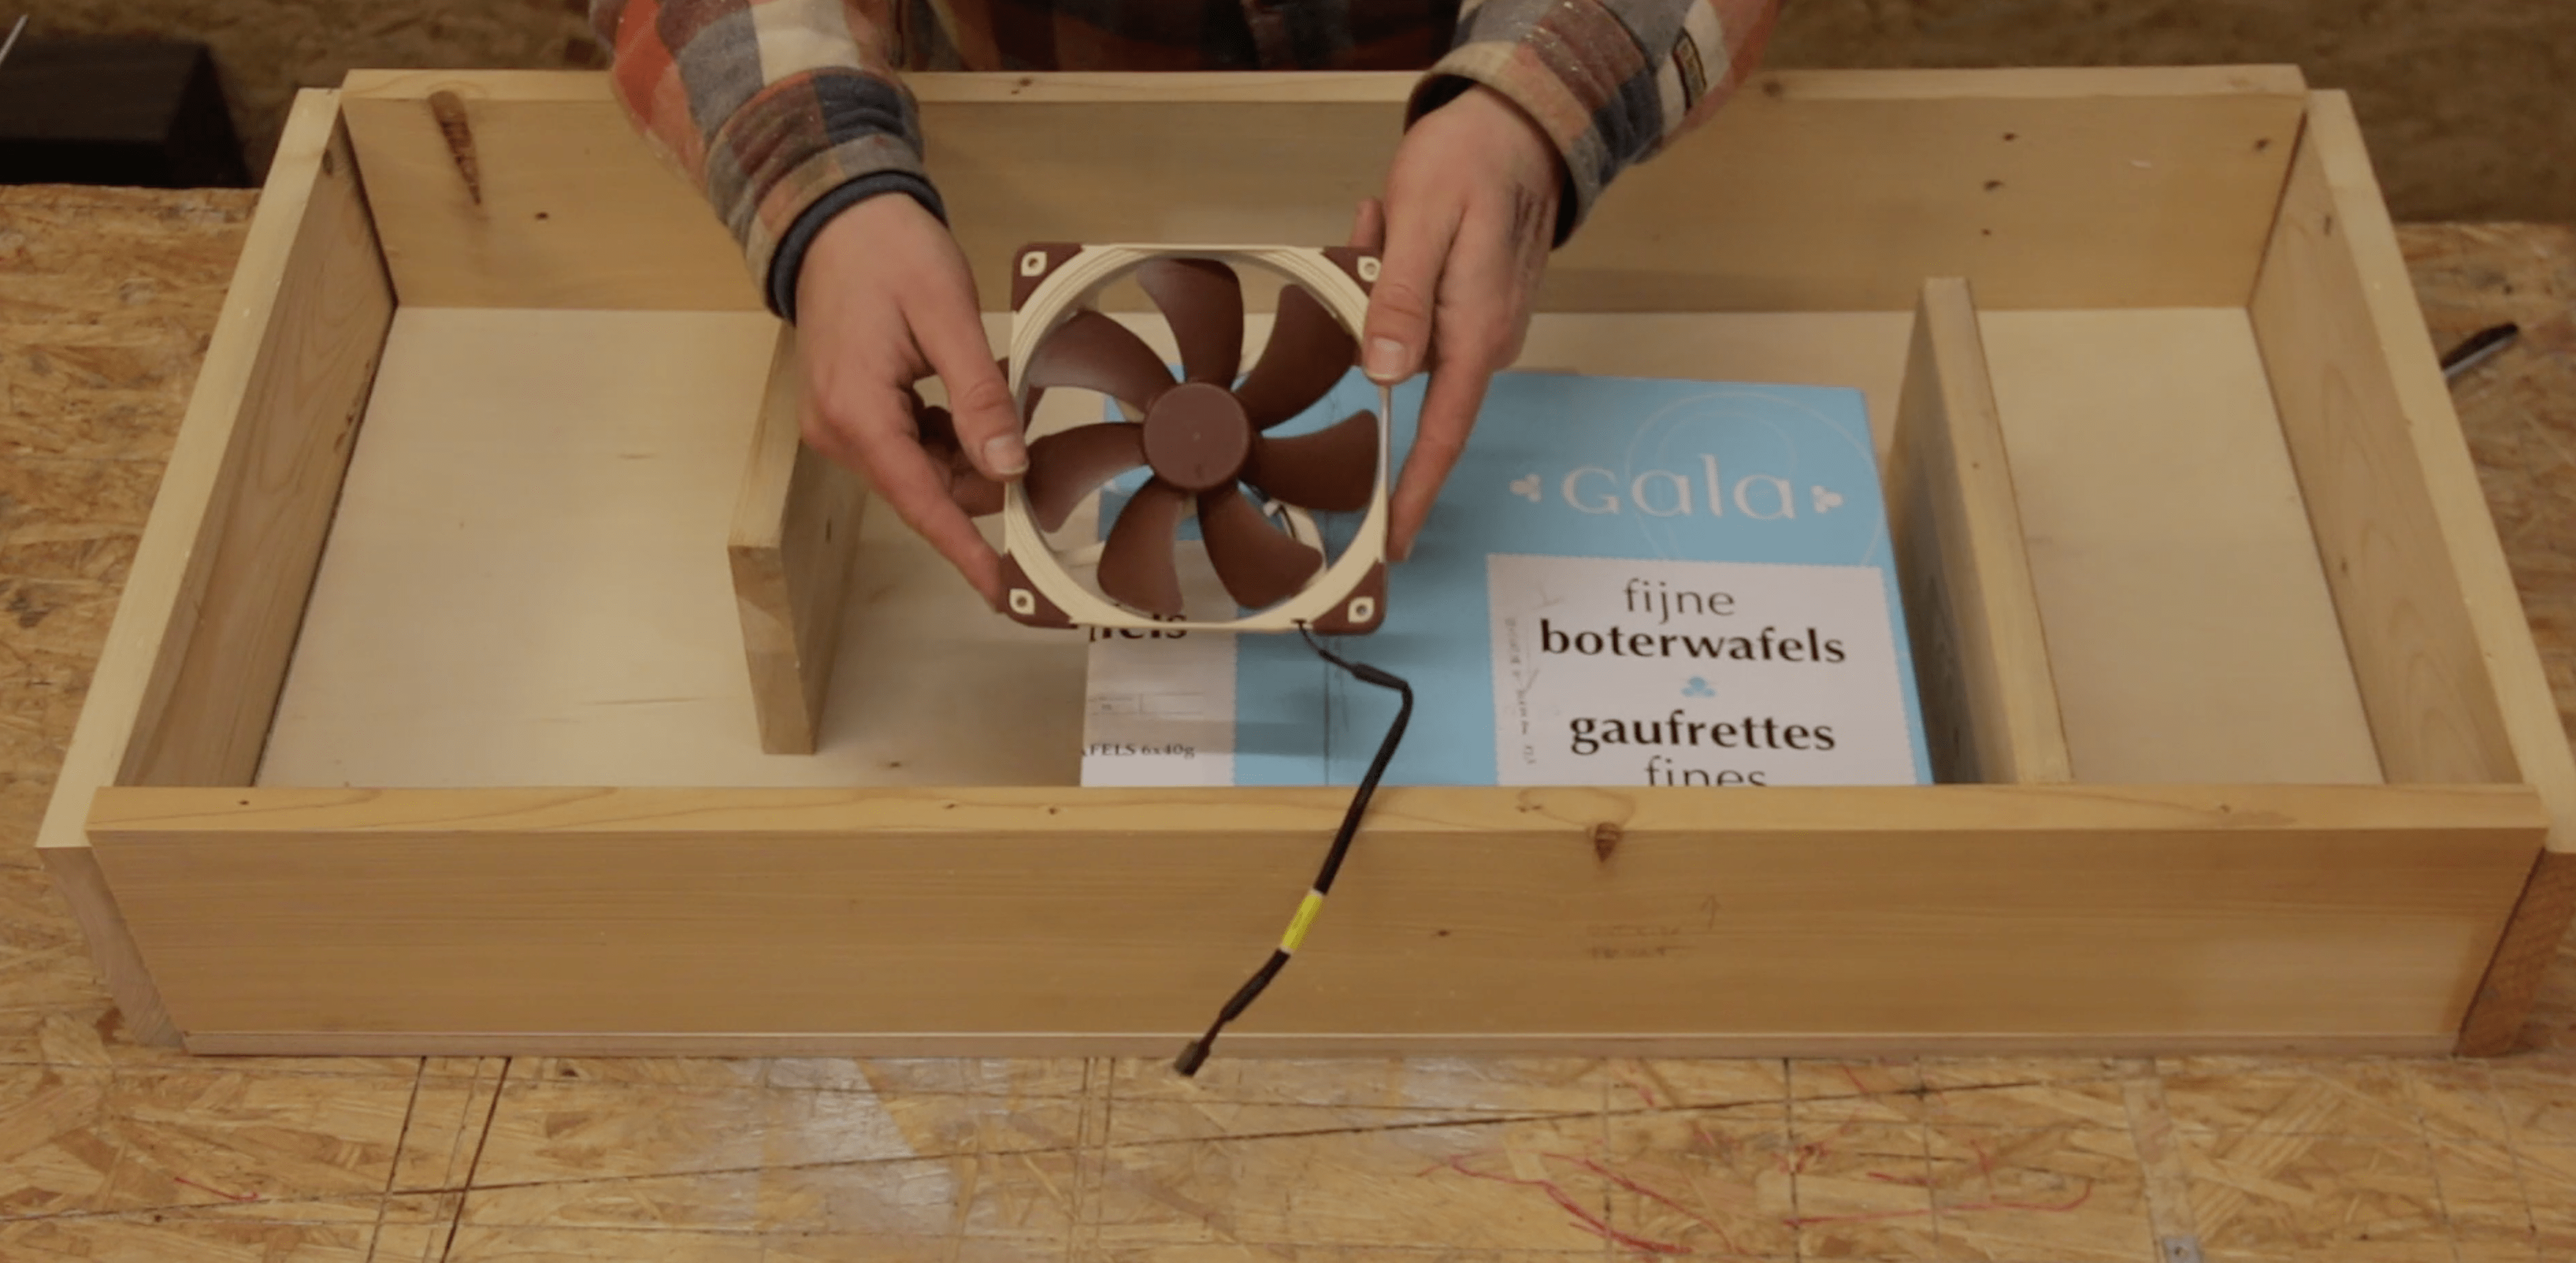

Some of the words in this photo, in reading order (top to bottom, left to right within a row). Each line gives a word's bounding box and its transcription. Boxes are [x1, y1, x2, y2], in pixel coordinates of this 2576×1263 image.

[1560, 453, 1796, 520] Gala
[1623, 577, 1736, 625] fijne
[1539, 617, 1846, 664] boterwafels
[1081, 743, 1136, 756] FELS
[1569, 708, 1837, 756] gaufrettes
[1645, 755, 1768, 787] fines
